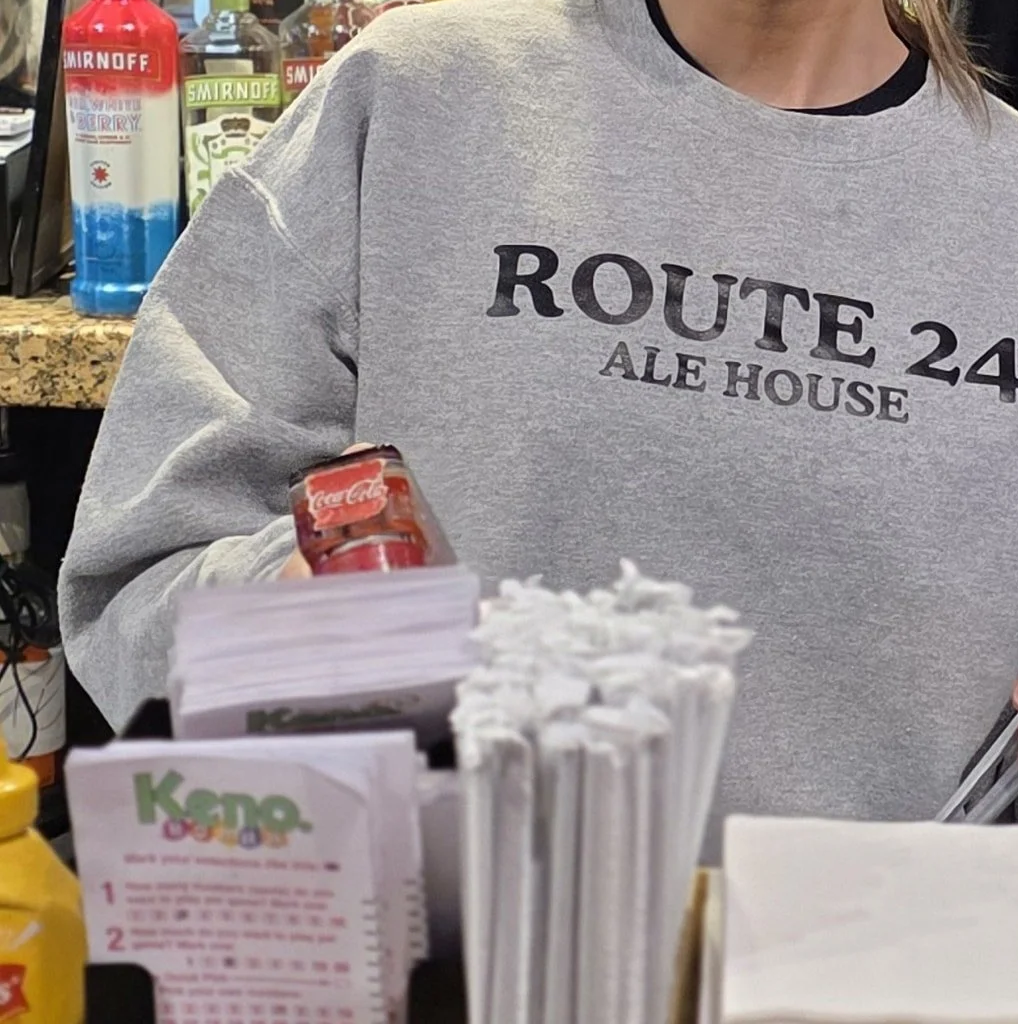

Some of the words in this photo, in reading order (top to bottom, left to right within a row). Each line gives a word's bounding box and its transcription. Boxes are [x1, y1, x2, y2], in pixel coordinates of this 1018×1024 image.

[188, 80, 278, 102] SMIRNOFF
[485, 243, 877, 368] ROUTE
[598, 340, 707, 392] ALE
[723, 360, 910, 424] HOUSE
[133, 770, 303, 833] Keno
[106, 927, 126, 952] 2
